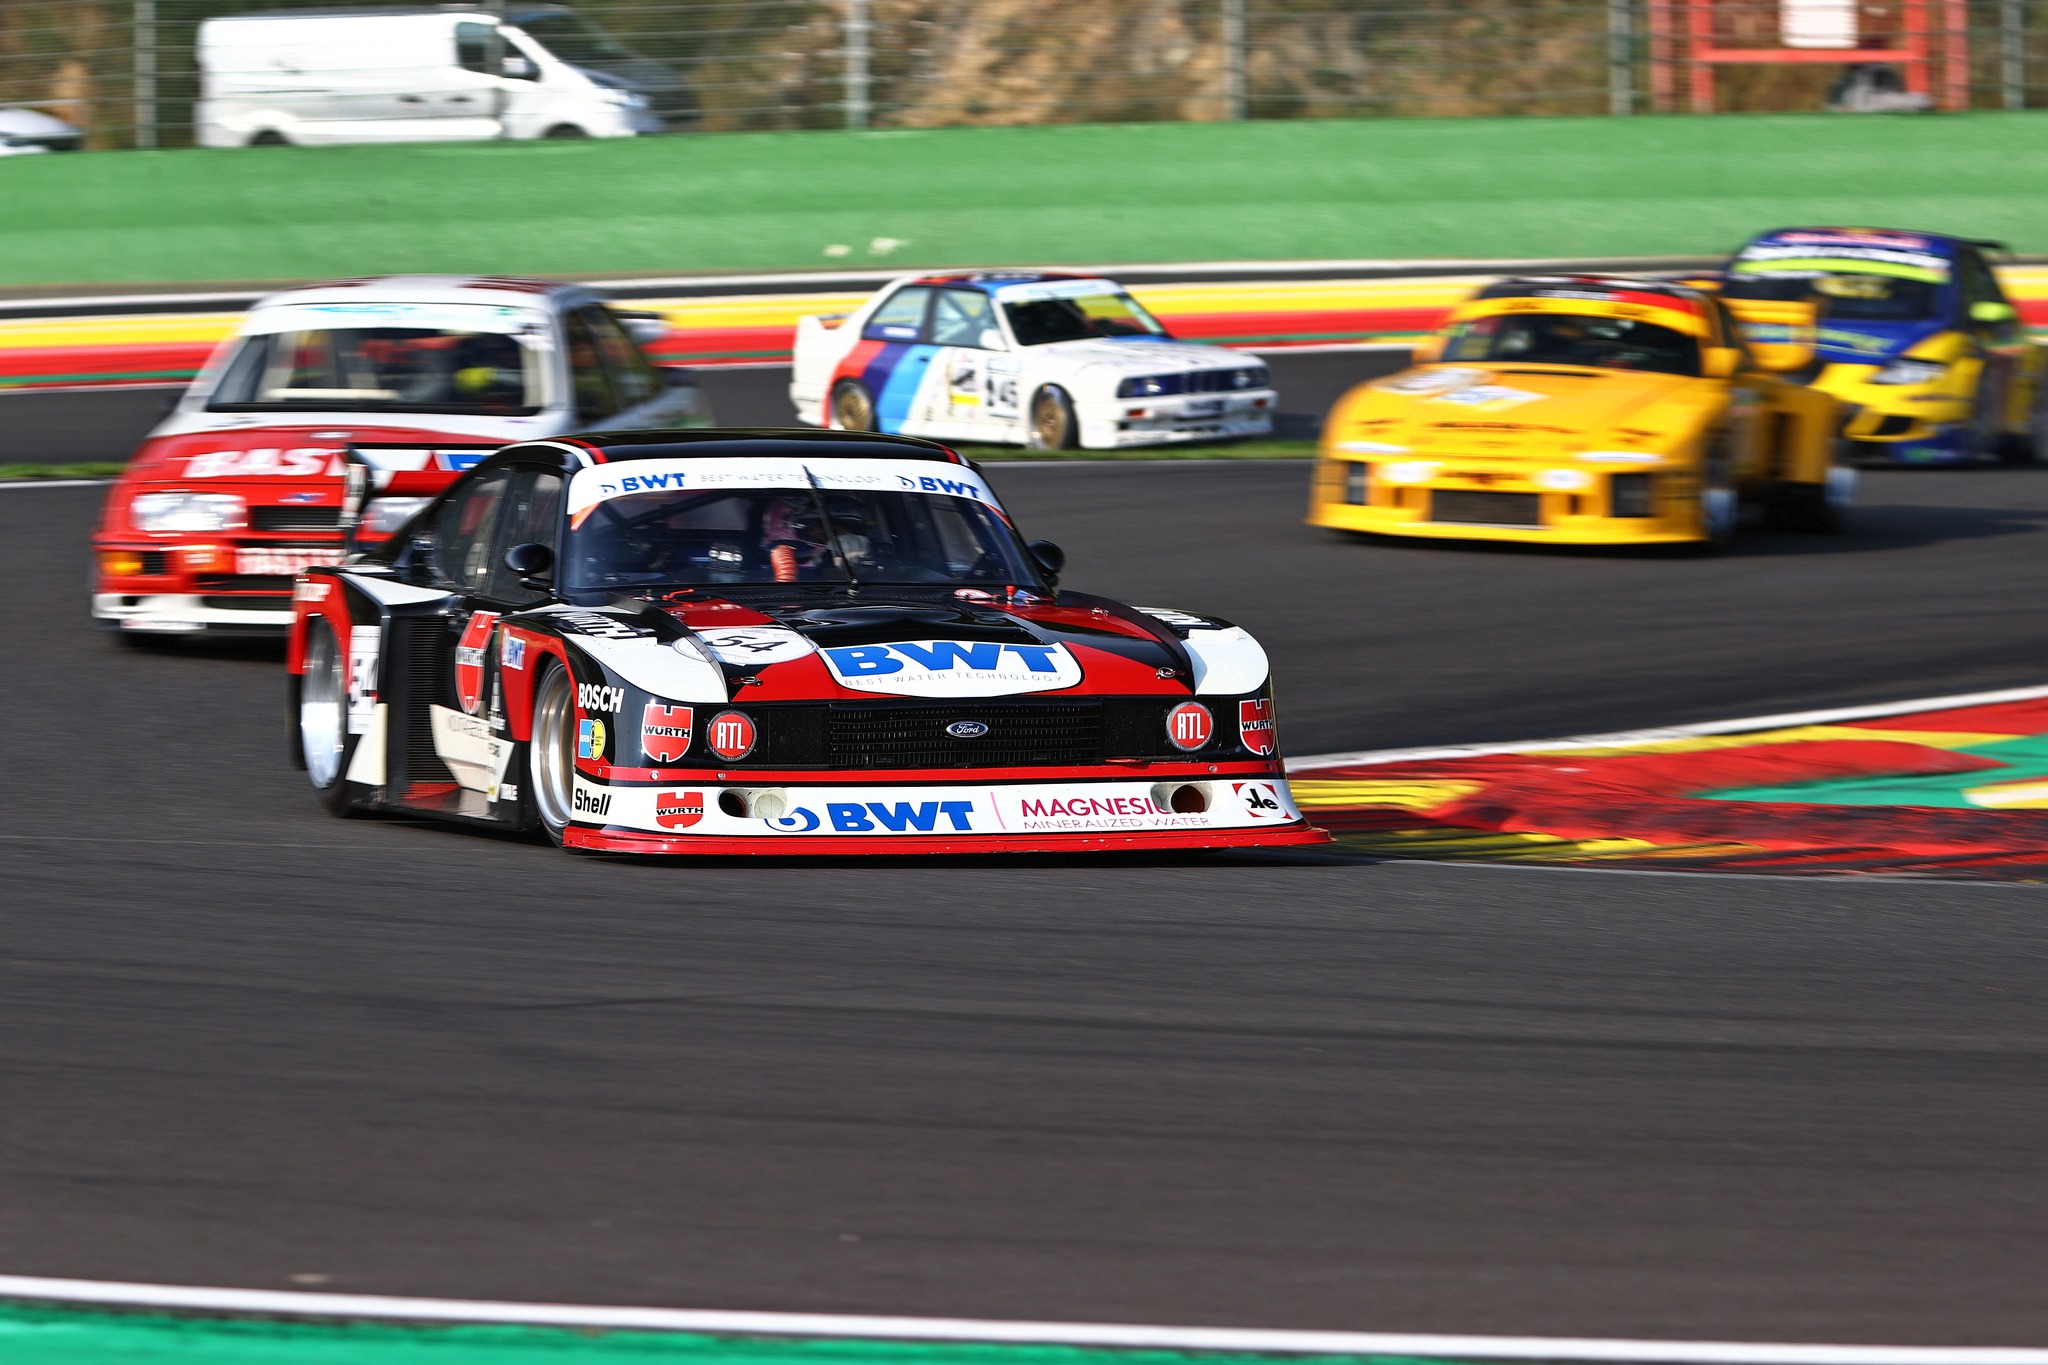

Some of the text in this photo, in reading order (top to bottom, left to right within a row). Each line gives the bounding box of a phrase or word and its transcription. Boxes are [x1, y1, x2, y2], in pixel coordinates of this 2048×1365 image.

[621, 472, 686, 492] BWT
[786, 473, 882, 484] TENOLOGY
[918, 476, 981, 499] BWT
[704, 635, 789, 653] 54
[824, 641, 1058, 677] BWT
[844, 671, 1062, 687] BEST WATER TECHNOLOGY
[577, 682, 625, 714] BOSCH
[716, 721, 746, 750] RTL
[956, 723, 980, 734] Ford
[1177, 712, 1205, 740] RTL
[574, 787, 612, 816] Shell
[1020, 797, 1202, 818] MAGNESI
[826, 801, 974, 832] BWT
[1023, 817, 1212, 829] MINERALIZED WATER
